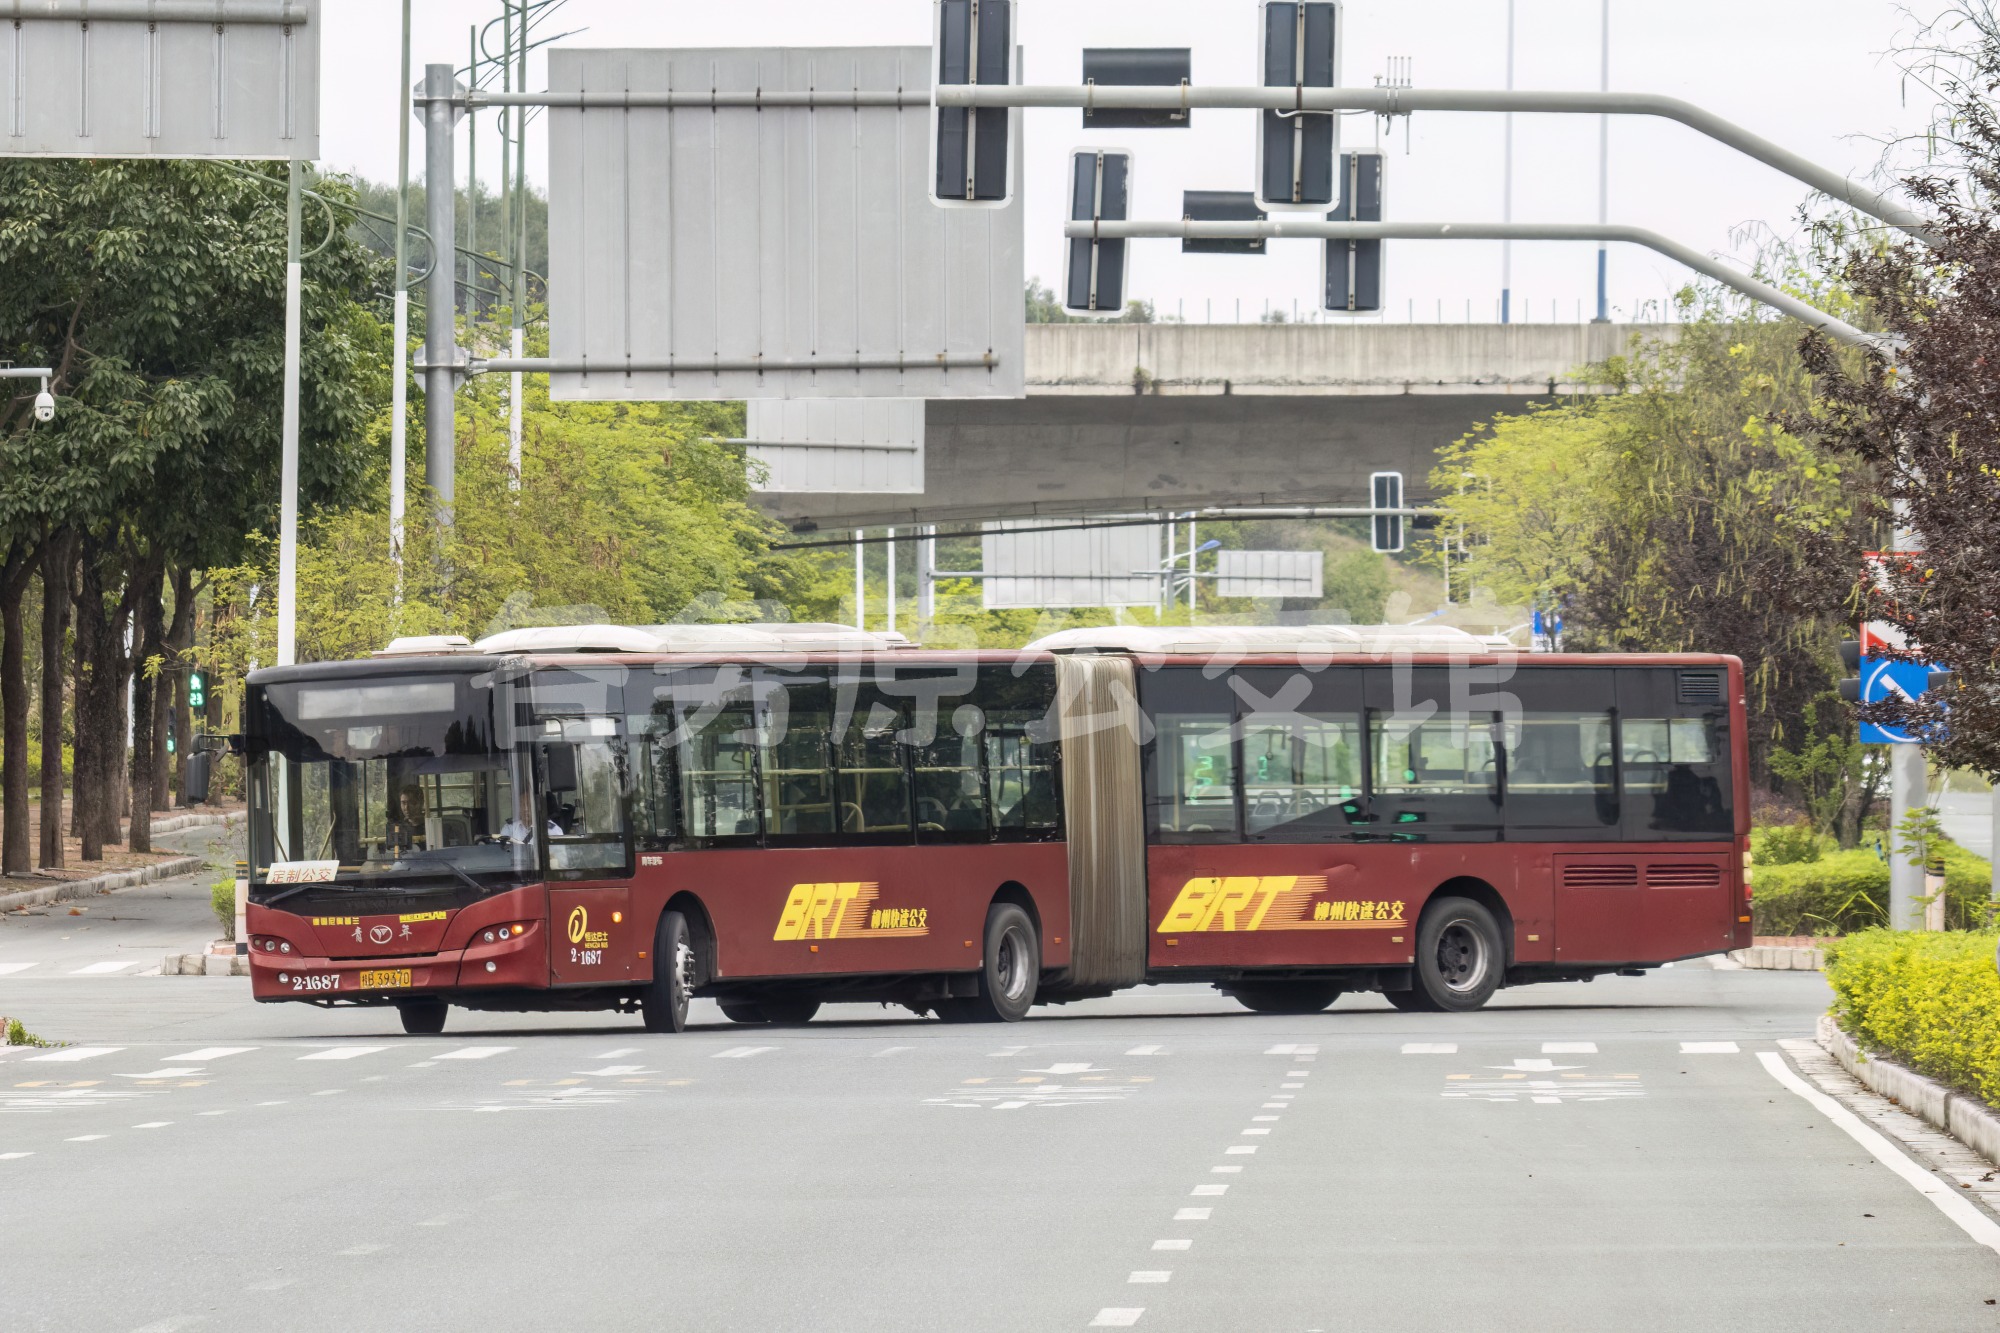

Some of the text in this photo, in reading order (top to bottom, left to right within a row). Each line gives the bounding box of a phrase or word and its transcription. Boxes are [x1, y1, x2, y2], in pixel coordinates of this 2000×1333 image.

[271, 867, 331, 884] 定制公交
[773, 882, 860, 941] BRT
[1157, 876, 1298, 932] BRT
[1314, 900, 1405, 921] 柳州快速公交
[871, 907, 927, 929] 柳州快速公交
